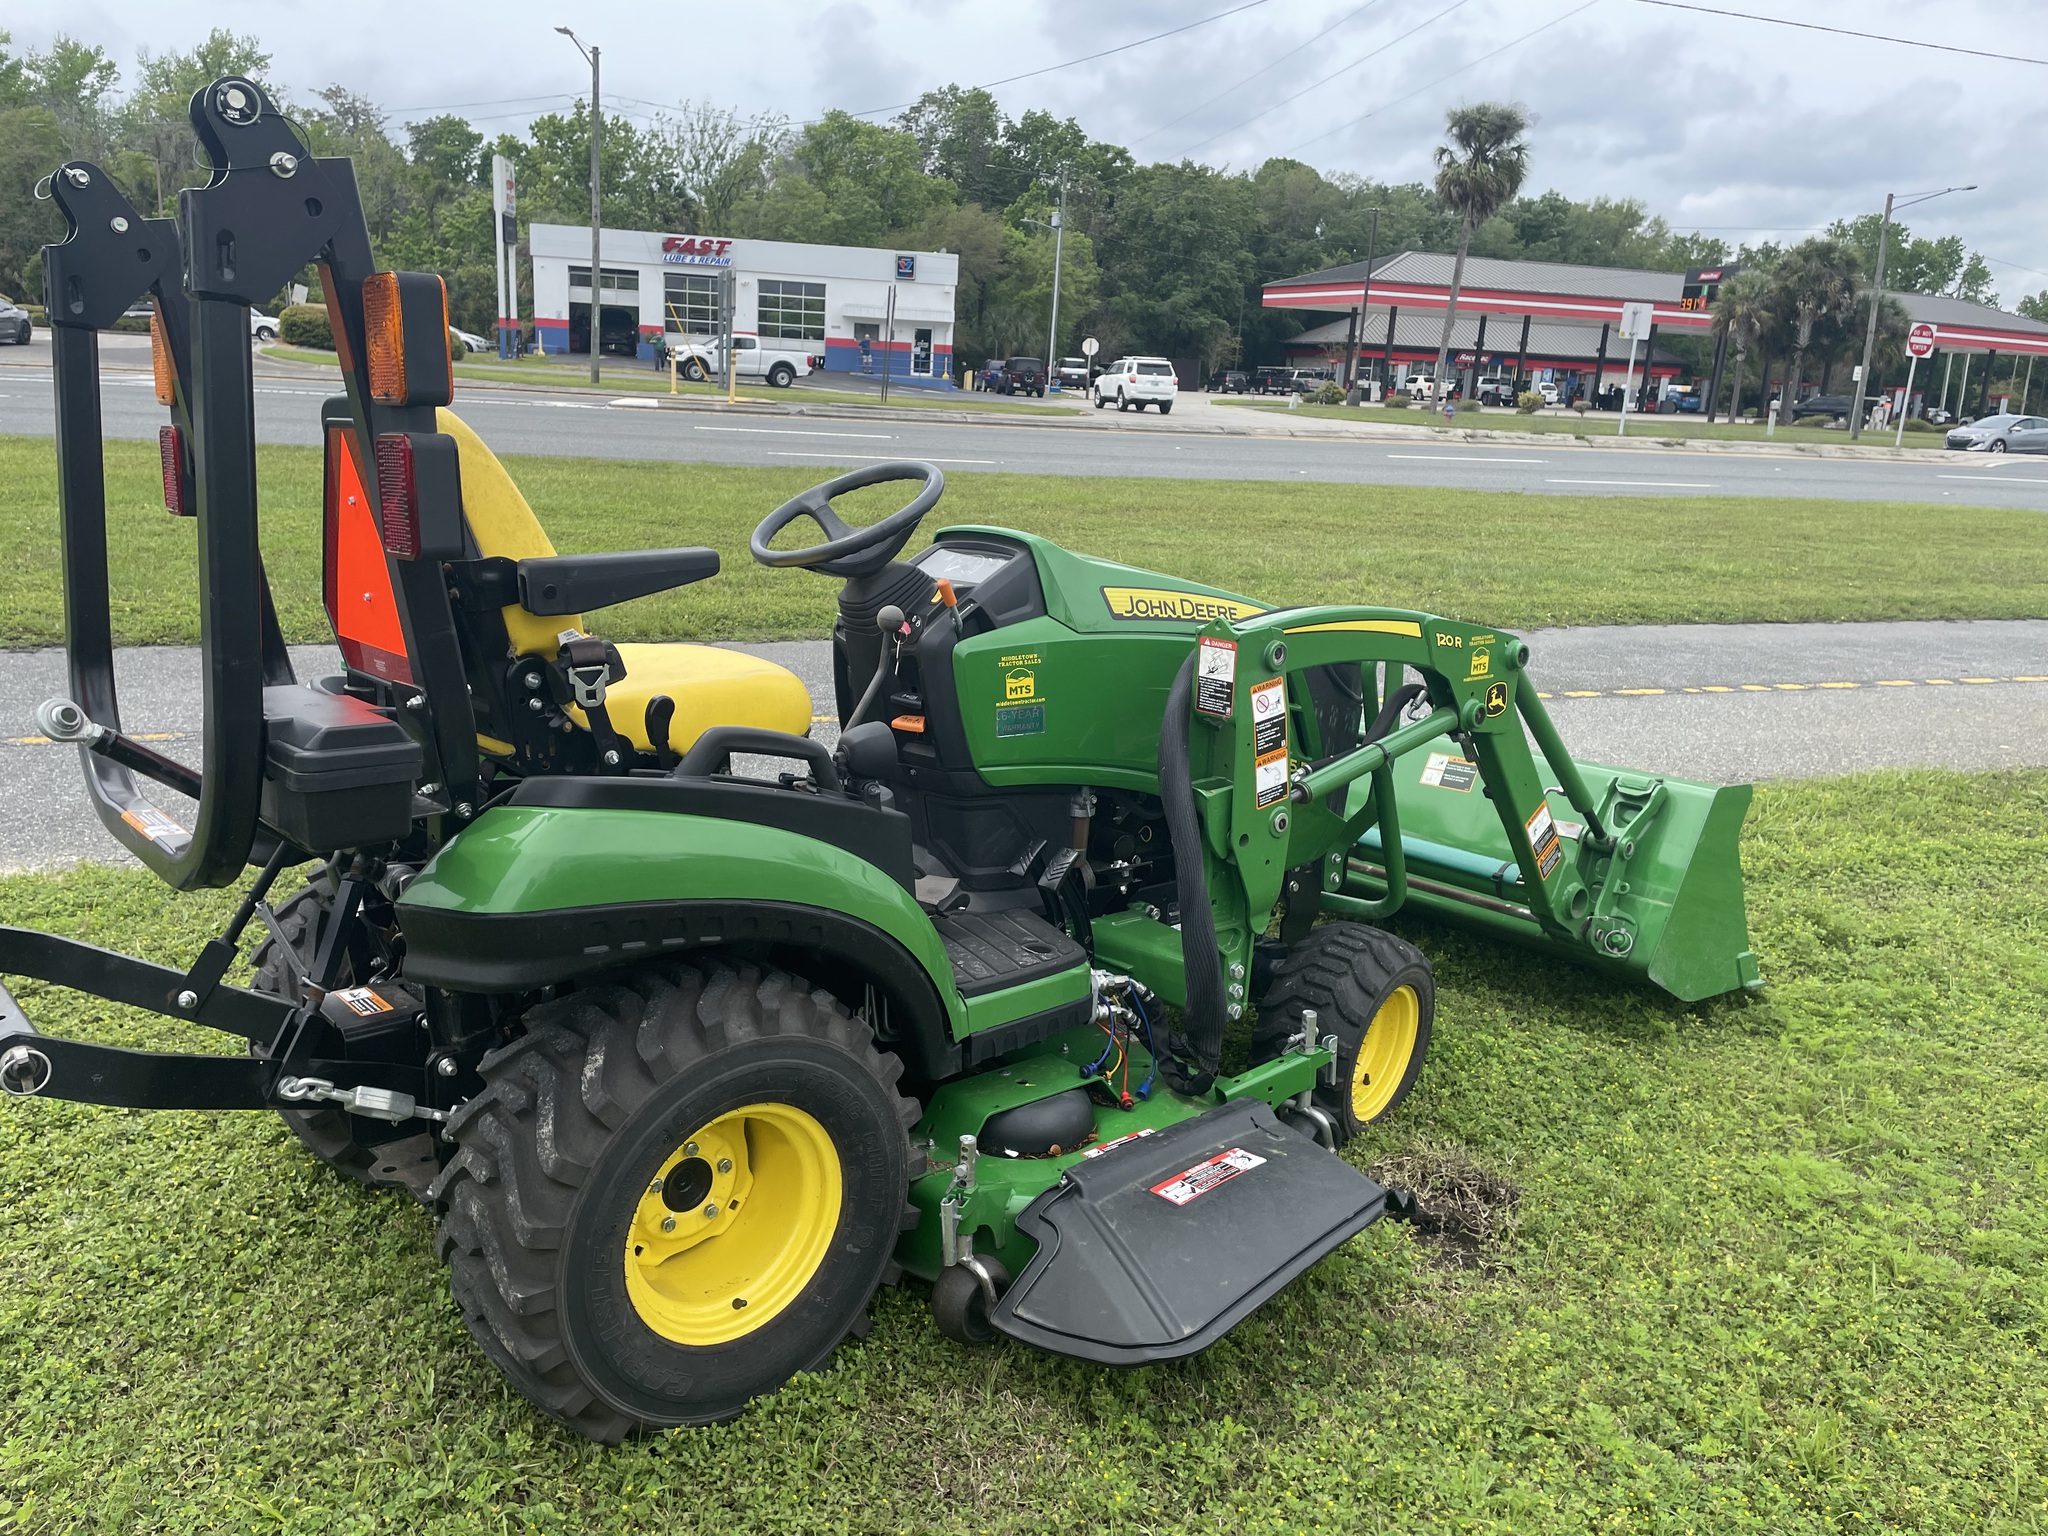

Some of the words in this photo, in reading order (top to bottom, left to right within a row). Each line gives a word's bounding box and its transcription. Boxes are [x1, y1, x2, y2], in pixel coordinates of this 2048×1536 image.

[662, 237, 733, 256] FAST
[663, 254, 688, 263] LUBE
[698, 257, 731, 266] REPAIR
[1124, 595, 1177, 617] JOHN
[1179, 598, 1238, 621] DEERE
[1211, 640, 1233, 649] DANGER
[997, 660, 1024, 668] TRACTOR
[1024, 658, 1042, 666] SALES
[1001, 653, 1038, 662] MIDDLETOWN
[1473, 662, 1487, 672] MTS
[1009, 684, 1032, 696] MTS
[1256, 678, 1282, 692] WARNING
[1001, 709, 1040, 721] 6-YEAR
[1002, 721, 1040, 732] WARRANTY
[1261, 750, 1287, 765] WARNING
[591, 1245, 694, 1398] CARLISLE
